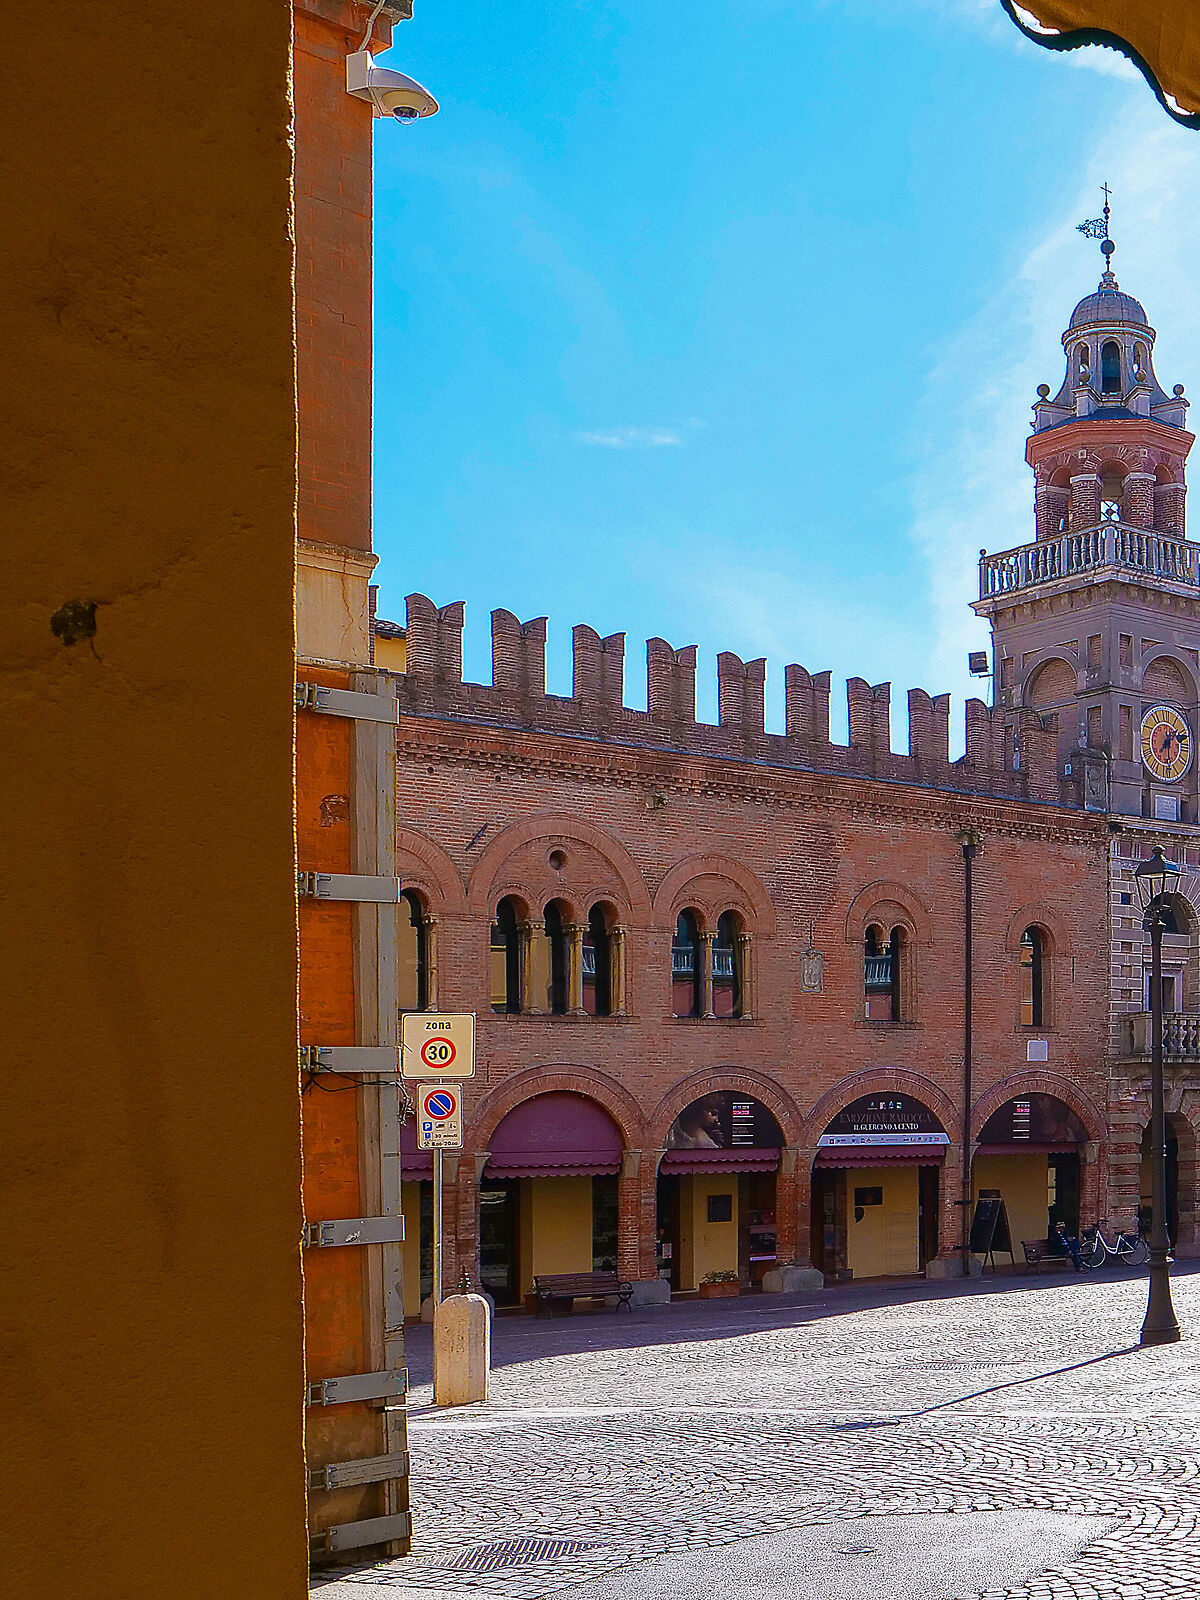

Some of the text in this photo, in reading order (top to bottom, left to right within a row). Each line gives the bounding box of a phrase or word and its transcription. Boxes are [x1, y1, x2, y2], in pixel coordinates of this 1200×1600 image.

[425, 1021, 452, 1030] zona
[428, 1045, 448, 1060] 30
[860, 1123, 892, 1131] GUERCINO
[897, 1122, 919, 1130] CENTO
